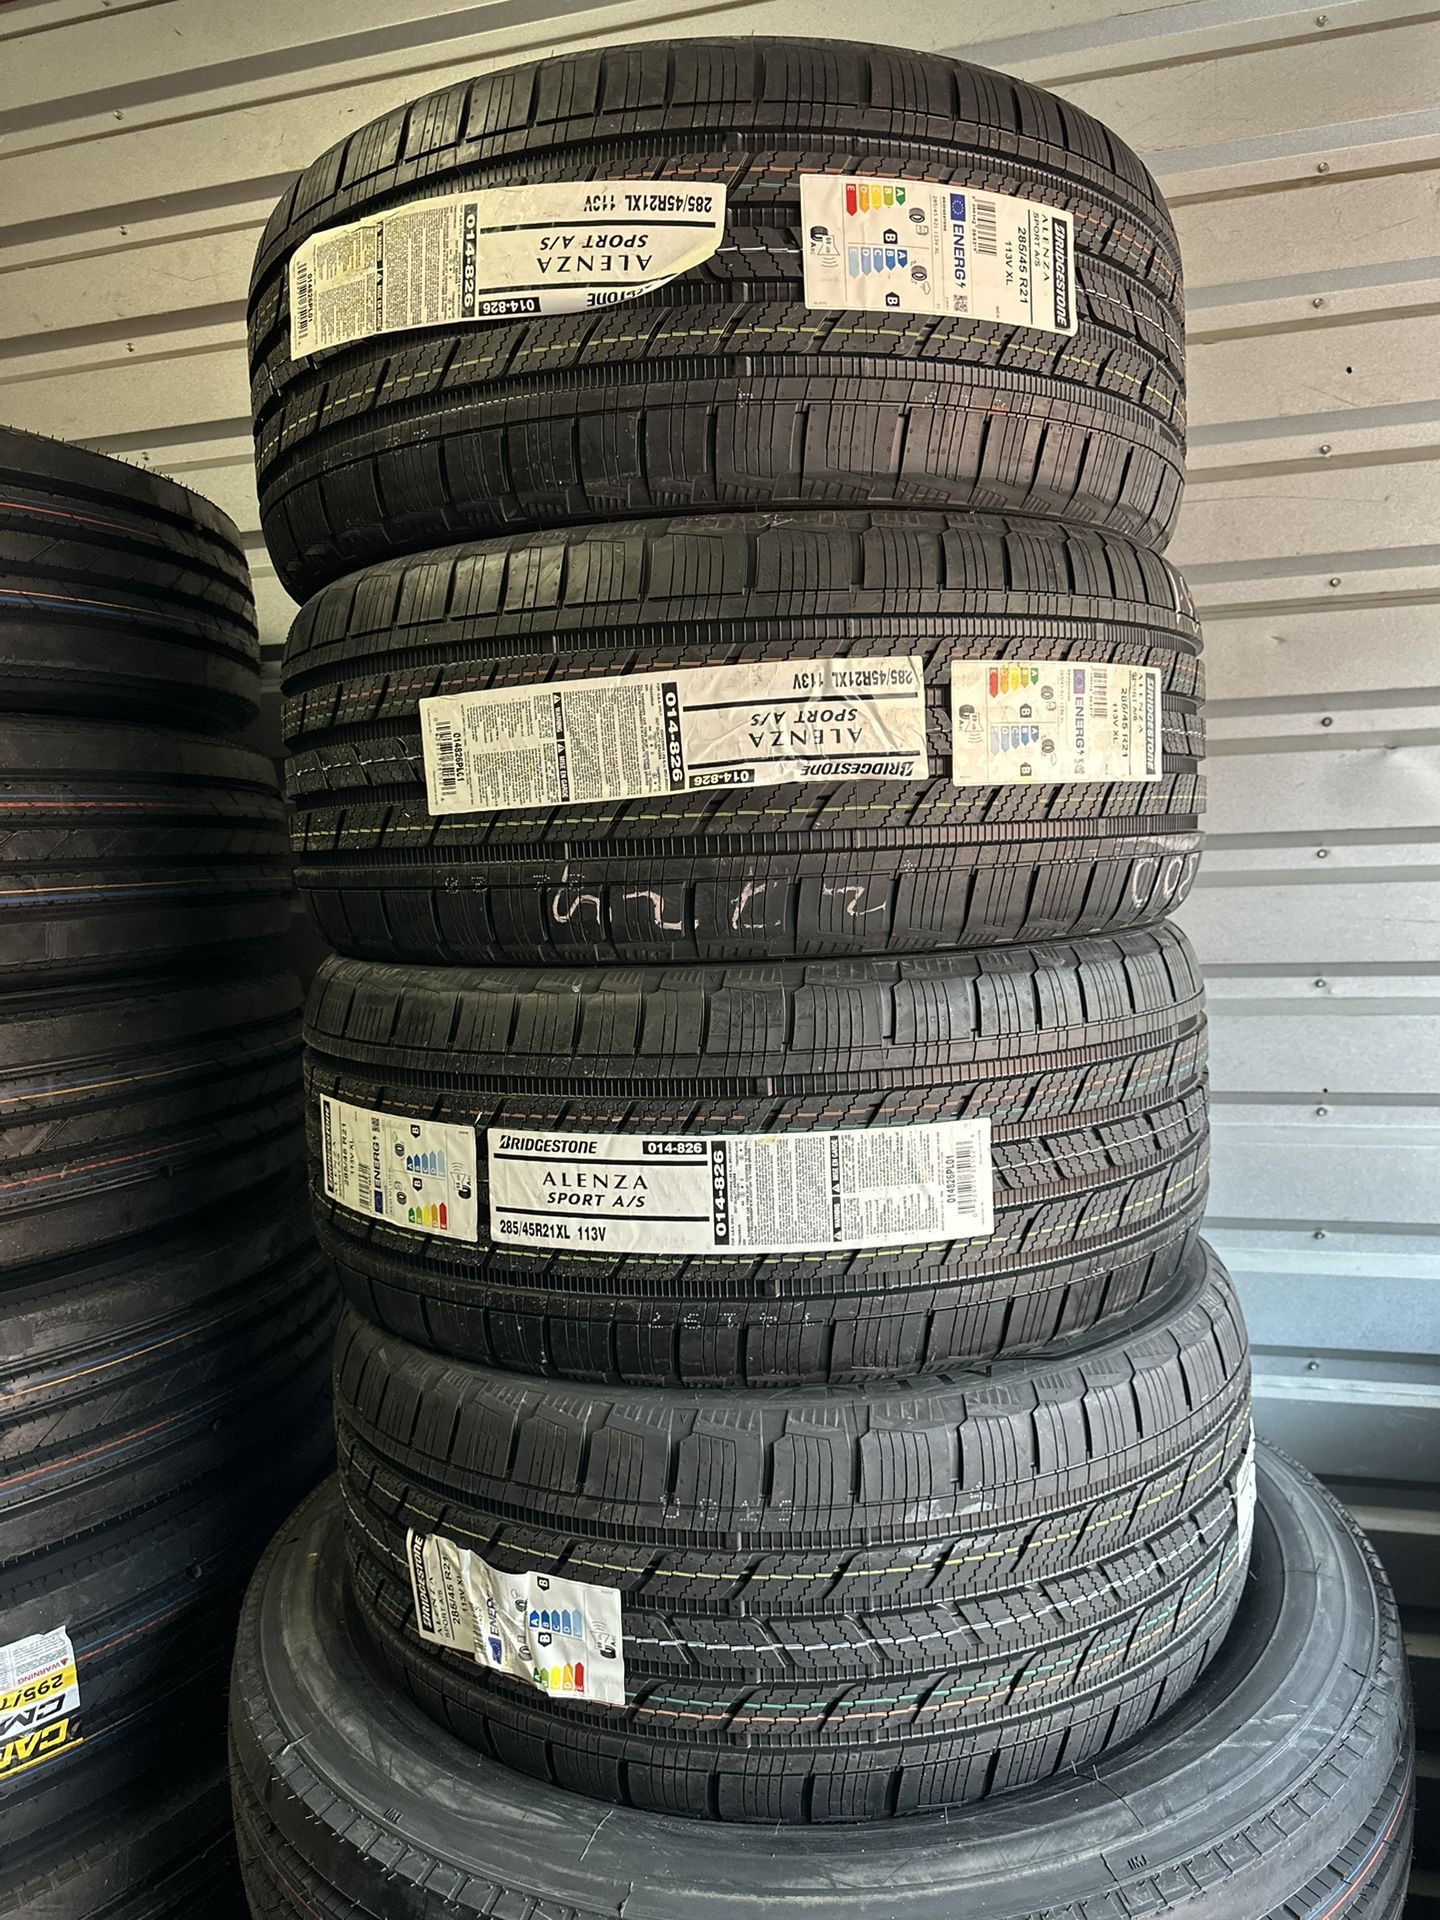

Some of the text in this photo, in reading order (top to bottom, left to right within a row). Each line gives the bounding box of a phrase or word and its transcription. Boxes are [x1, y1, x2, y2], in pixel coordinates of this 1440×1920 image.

[625, 194, 713, 213] 285/45R21XL
[885, 234, 894, 242] B
[1033, 212, 1041, 247] SPORT
[540, 234, 648, 250] SPORT A/S
[953, 224, 966, 280] ENERG
[1041, 213, 1050, 281] ALENZA
[464, 213, 476, 308] 014-826
[536, 255, 652, 273] ALENZA
[1018, 227, 1028, 303] 285/45 R21
[1006, 272, 1013, 286] XL
[1054, 222, 1067, 326] BRIDGESTONE
[888, 296, 897, 305] B
[793, 670, 913, 690] 285/45R21XL 113V
[751, 709, 857, 726] SPORT A/S
[1075, 697, 1084, 749] ENERG
[1147, 678, 1155, 771] BRIDGESTONE
[665, 692, 683, 782] 014-826
[748, 728, 862, 748] ALENZA
[694, 772, 750, 785] 014-826
[801, 762, 914, 777] BRIDGESTONE
[499, 1135, 702, 1154] BRIDGESTONE 014-826
[372, 1142, 381, 1189] ENERG
[543, 1171, 648, 1190] ALENZA
[946, 1155, 956, 1203] 014826PL01
[547, 1192, 645, 1208] SPORT A/S
[713, 1150, 727, 1237] 014-826
[500, 1220, 606, 1241] 285/45R21XL 113V
[414, 1535, 433, 1628] BRIDGESTONE
[443, 1556, 461, 1625] 285/45 R21
[439, 1605, 450, 1638] SPORT
[541, 1634, 550, 1642] B
[18, 1662, 61, 1685] WARNING
